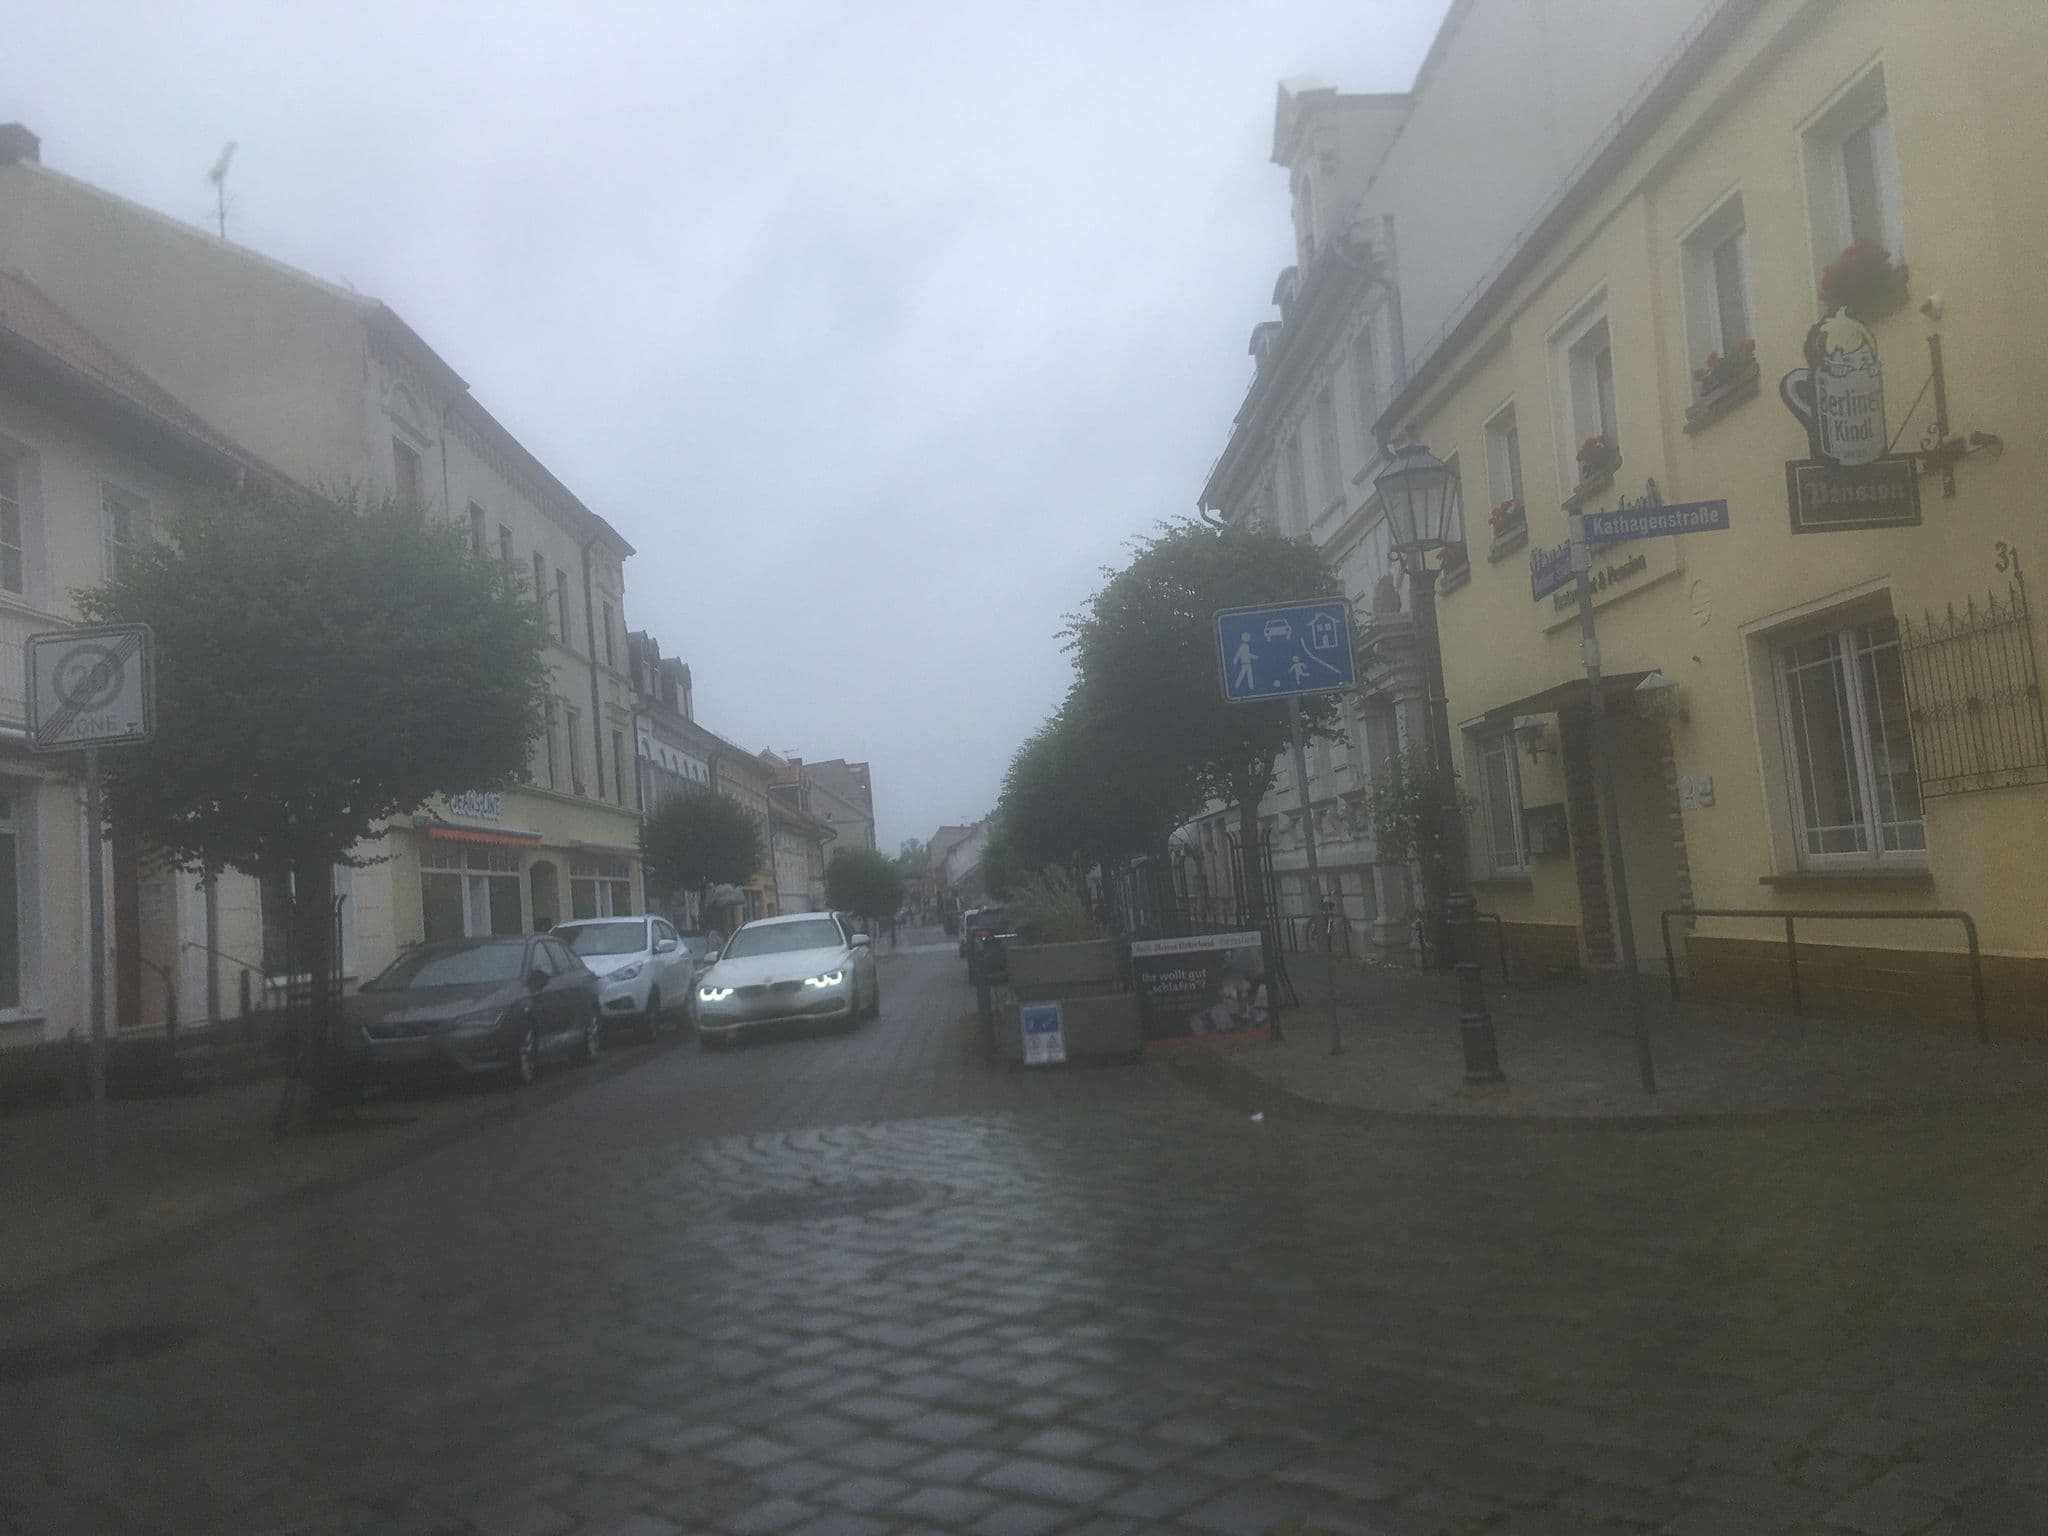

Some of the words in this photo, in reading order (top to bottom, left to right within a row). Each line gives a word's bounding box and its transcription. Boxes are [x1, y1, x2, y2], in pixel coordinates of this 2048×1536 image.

[1834, 416, 1873, 441] Kindl
[1592, 505, 1720, 537] Kathagenstraße
[64, 712, 119, 737] ZONE
[1159, 967, 1186, 981] wollt
[1188, 967, 1208, 983] gut
